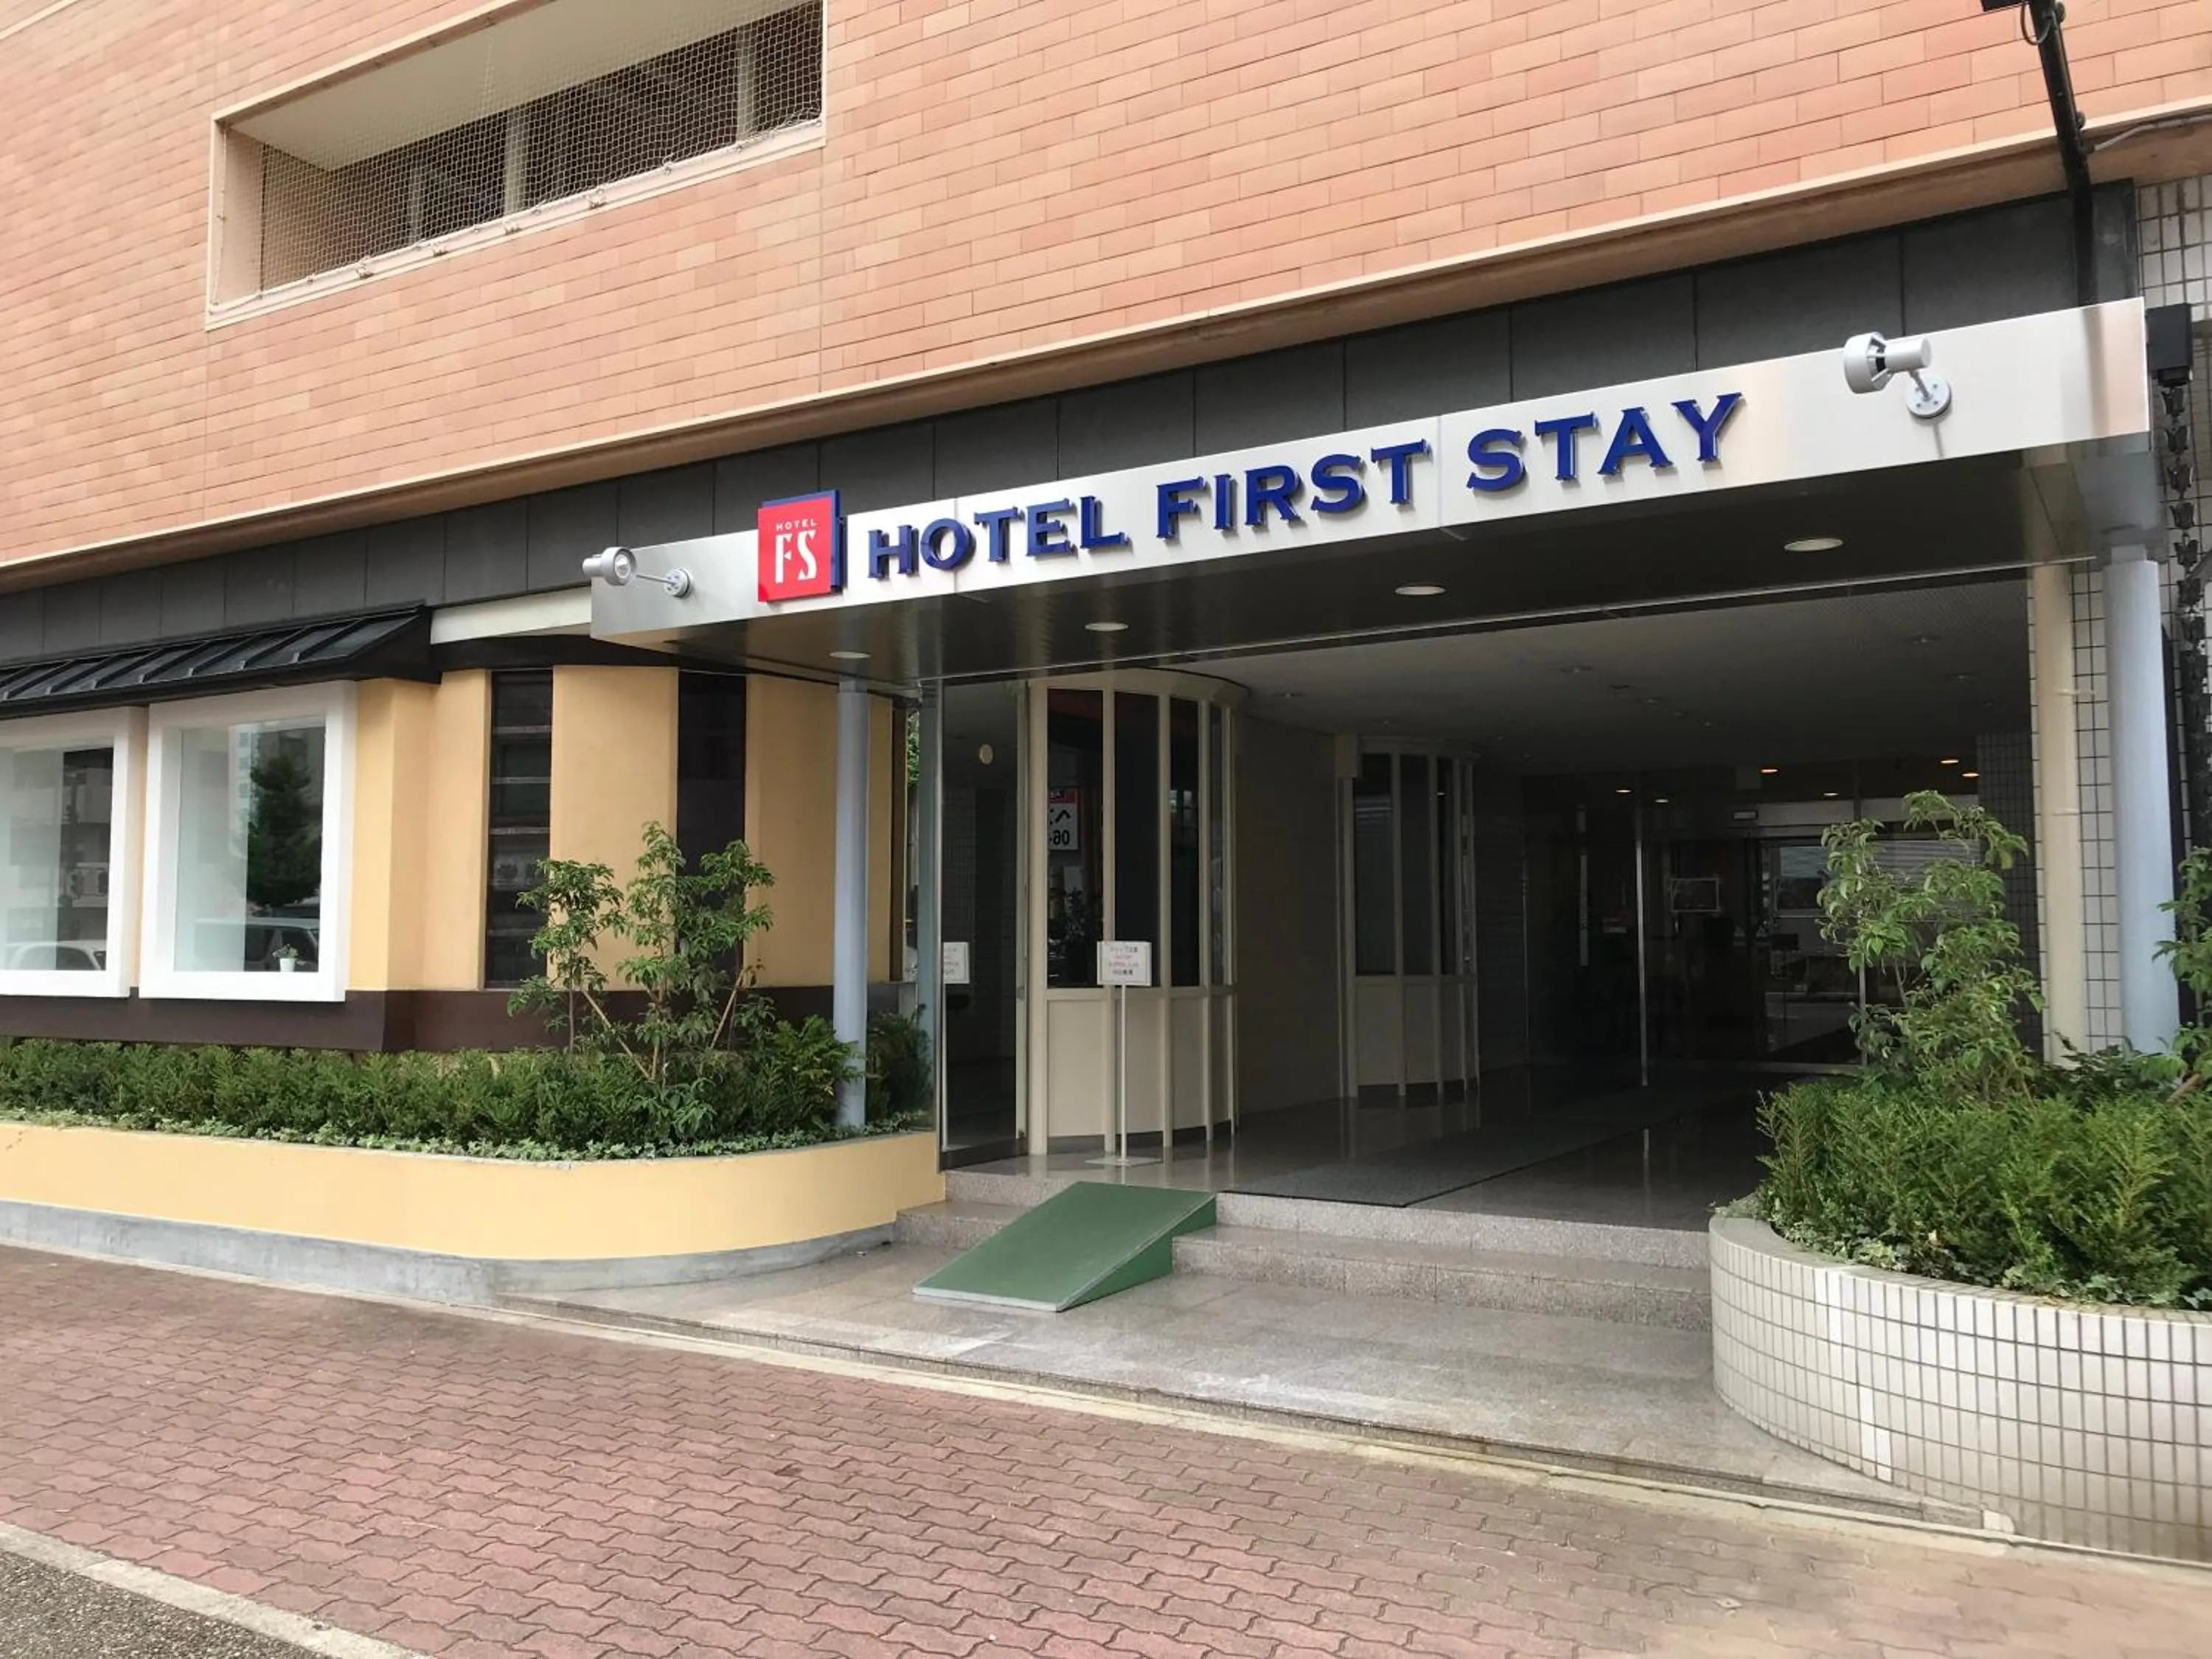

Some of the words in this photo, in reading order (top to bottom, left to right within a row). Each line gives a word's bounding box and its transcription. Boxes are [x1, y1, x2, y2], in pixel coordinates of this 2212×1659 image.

[867, 495, 1129, 578] HOTEL
[1156, 438, 1429, 539] FIRST
[1467, 392, 1742, 492] STAY
[776, 518, 817, 531] HOTEL
[775, 529, 817, 583] FS
